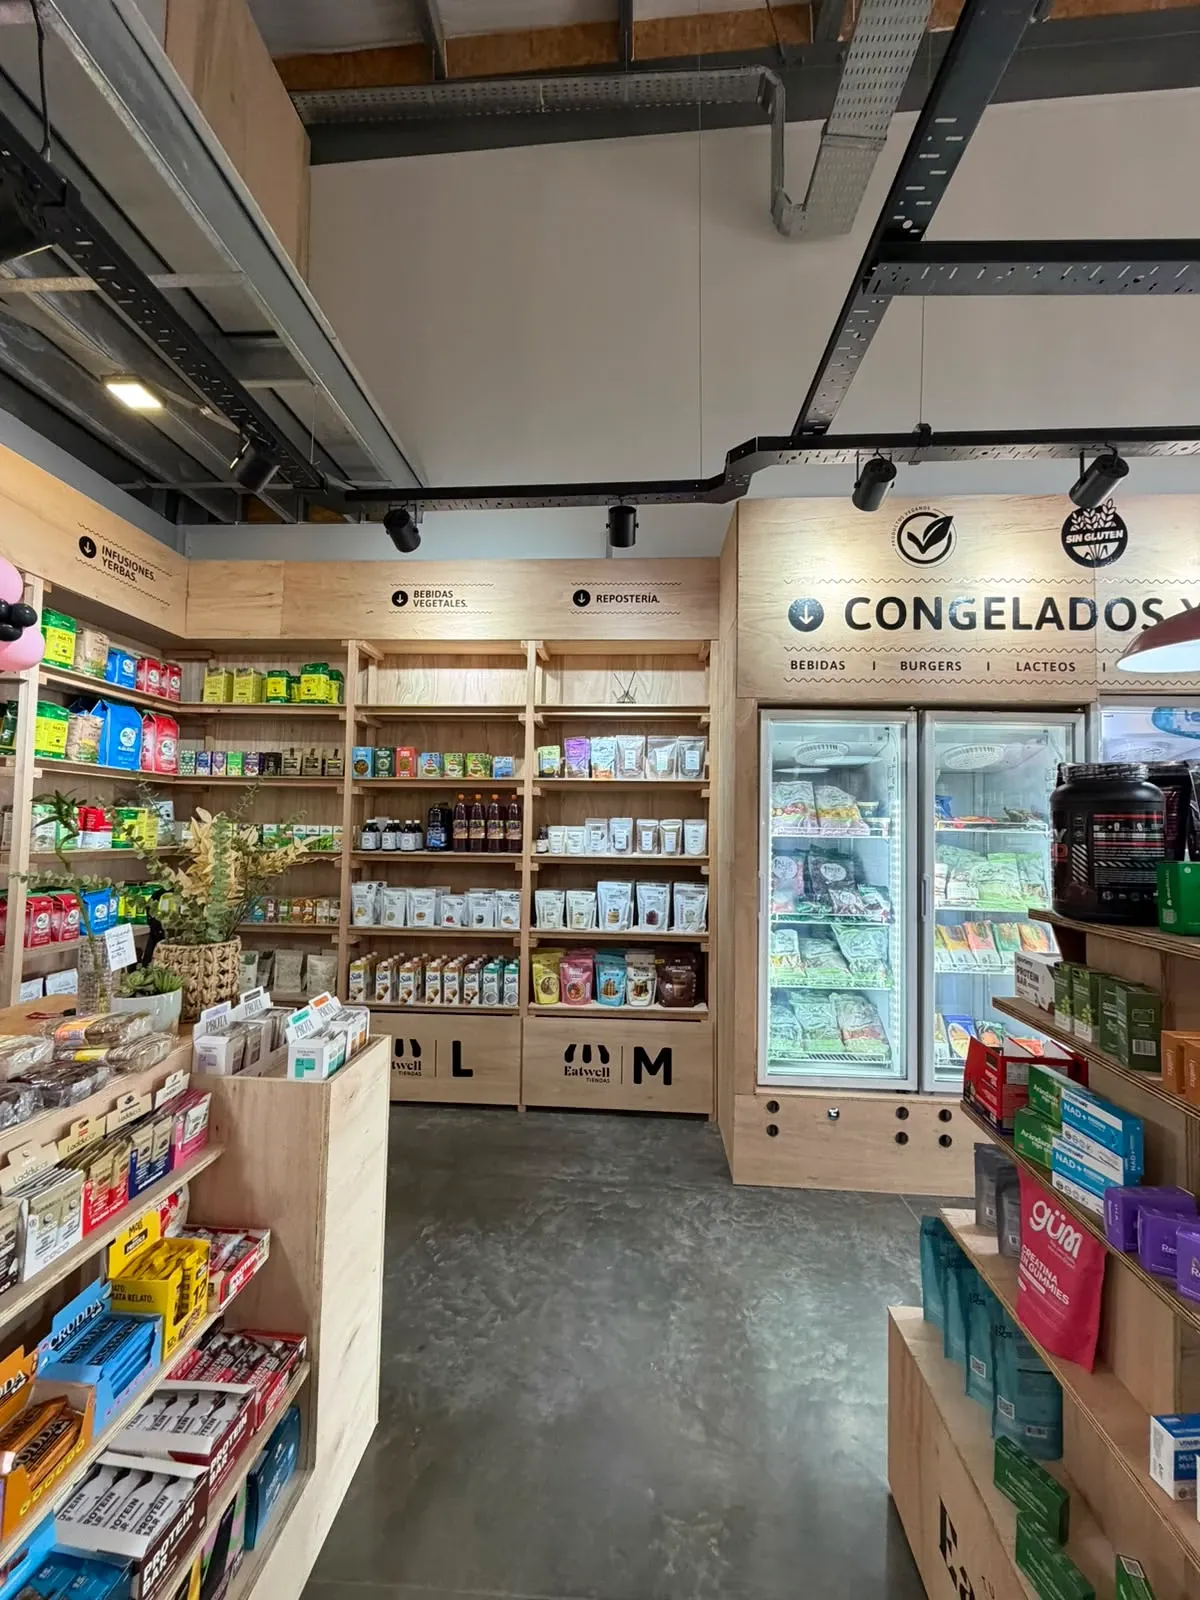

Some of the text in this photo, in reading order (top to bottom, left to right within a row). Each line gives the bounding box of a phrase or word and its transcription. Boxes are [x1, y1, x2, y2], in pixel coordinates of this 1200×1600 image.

[1066, 530, 1124, 544] SIN GLUTEN
[413, 590, 453, 599] BEBIDAS
[413, 599, 468, 608] VEGETALES.
[844, 596, 1164, 632] CONGELADOS
[790, 660, 846, 671] BEBIDAS
[900, 661, 962, 672] BURGERS
[1016, 661, 1077, 672] LACTEOS
[391, 1060, 422, 1072] twell
[452, 1040, 473, 1078] L
[564, 1065, 610, 1078] Eatwell
[633, 1046, 673, 1086] M
[1020, 1244, 1058, 1286] CREATINA
[1028, 1262, 1070, 1306] GUMMIES
[210, 1411, 248, 1473] PROTEIN
[58, 1493, 85, 1521] OTEIN
[143, 1501, 195, 1583] PROTEIN
[142, 1553, 168, 1599] BAR
